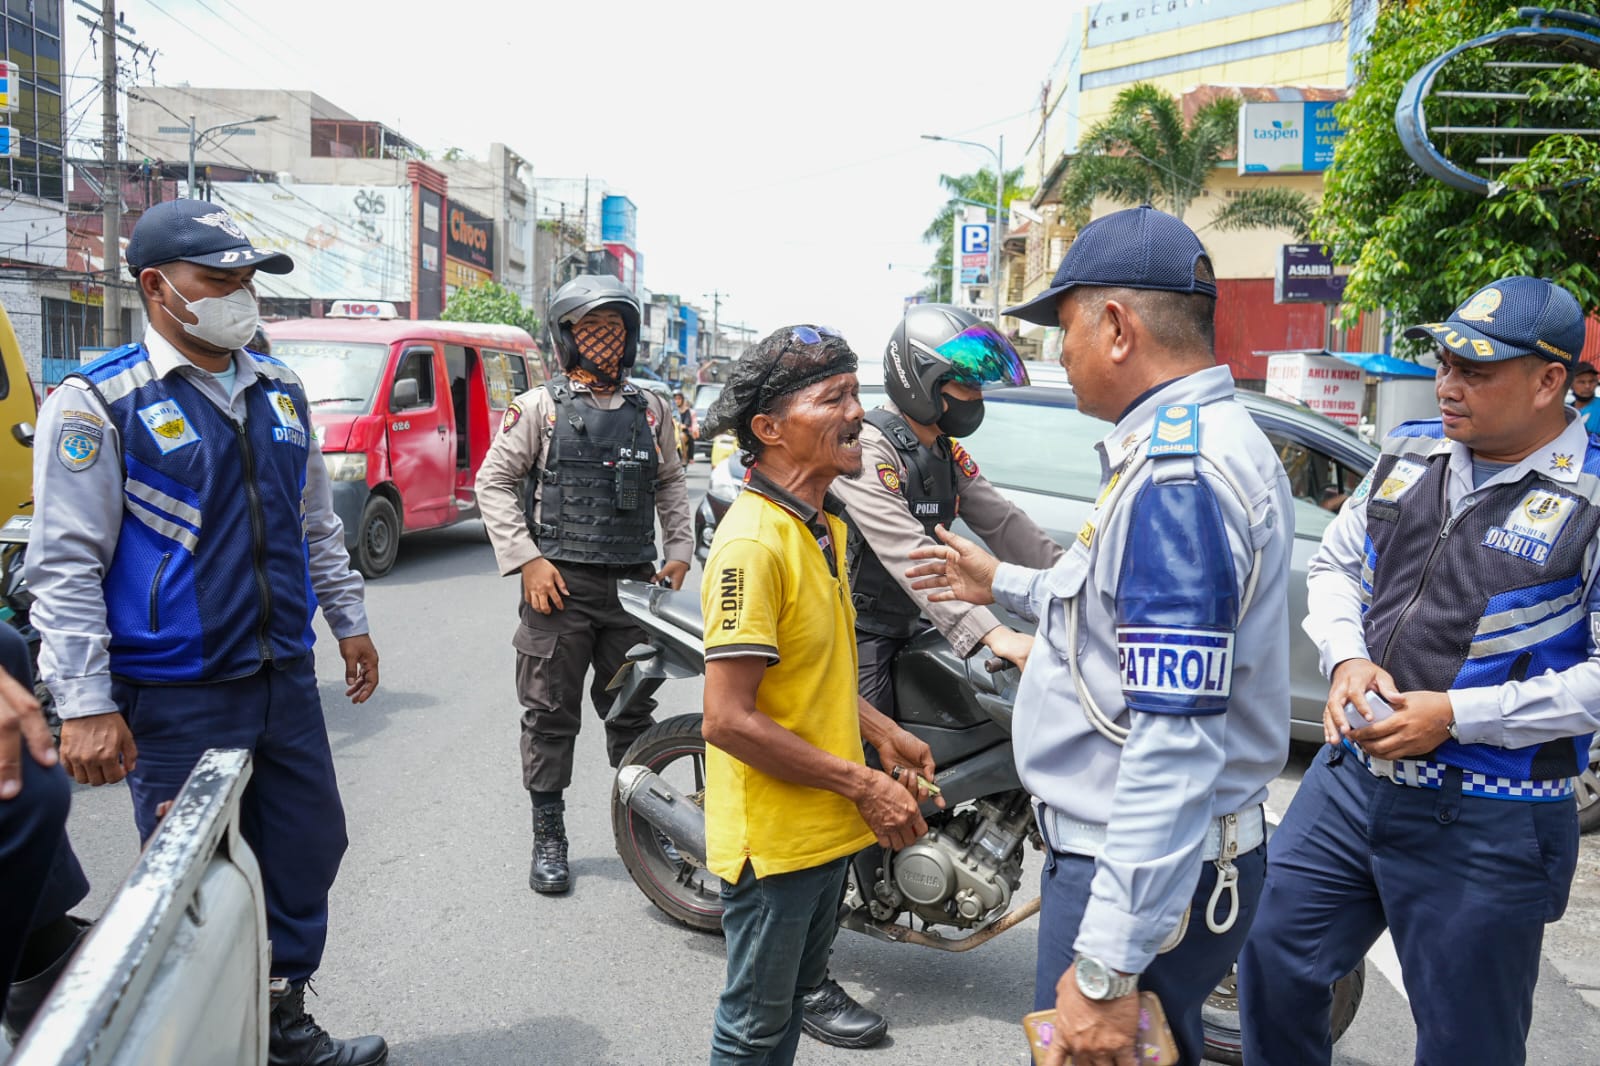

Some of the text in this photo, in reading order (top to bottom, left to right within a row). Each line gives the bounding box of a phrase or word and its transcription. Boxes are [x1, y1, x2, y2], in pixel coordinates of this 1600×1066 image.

[1254, 128, 1298, 141] taspen
[451, 209, 487, 251] Choco
[965, 226, 986, 251] P
[1288, 265, 1331, 276] ASABRI
[343, 303, 380, 315] 104
[1308, 368, 1329, 379] AHLI
[1331, 369, 1360, 381] KUNCI
[392, 421, 410, 431] 626
[620, 447, 649, 460] POISI
[1151, 443, 1194, 453] DISHUB
[1512, 523, 1547, 540] DISHUB
[1485, 529, 1548, 561] DISHUB
[1118, 647, 1227, 691] PATROLI
